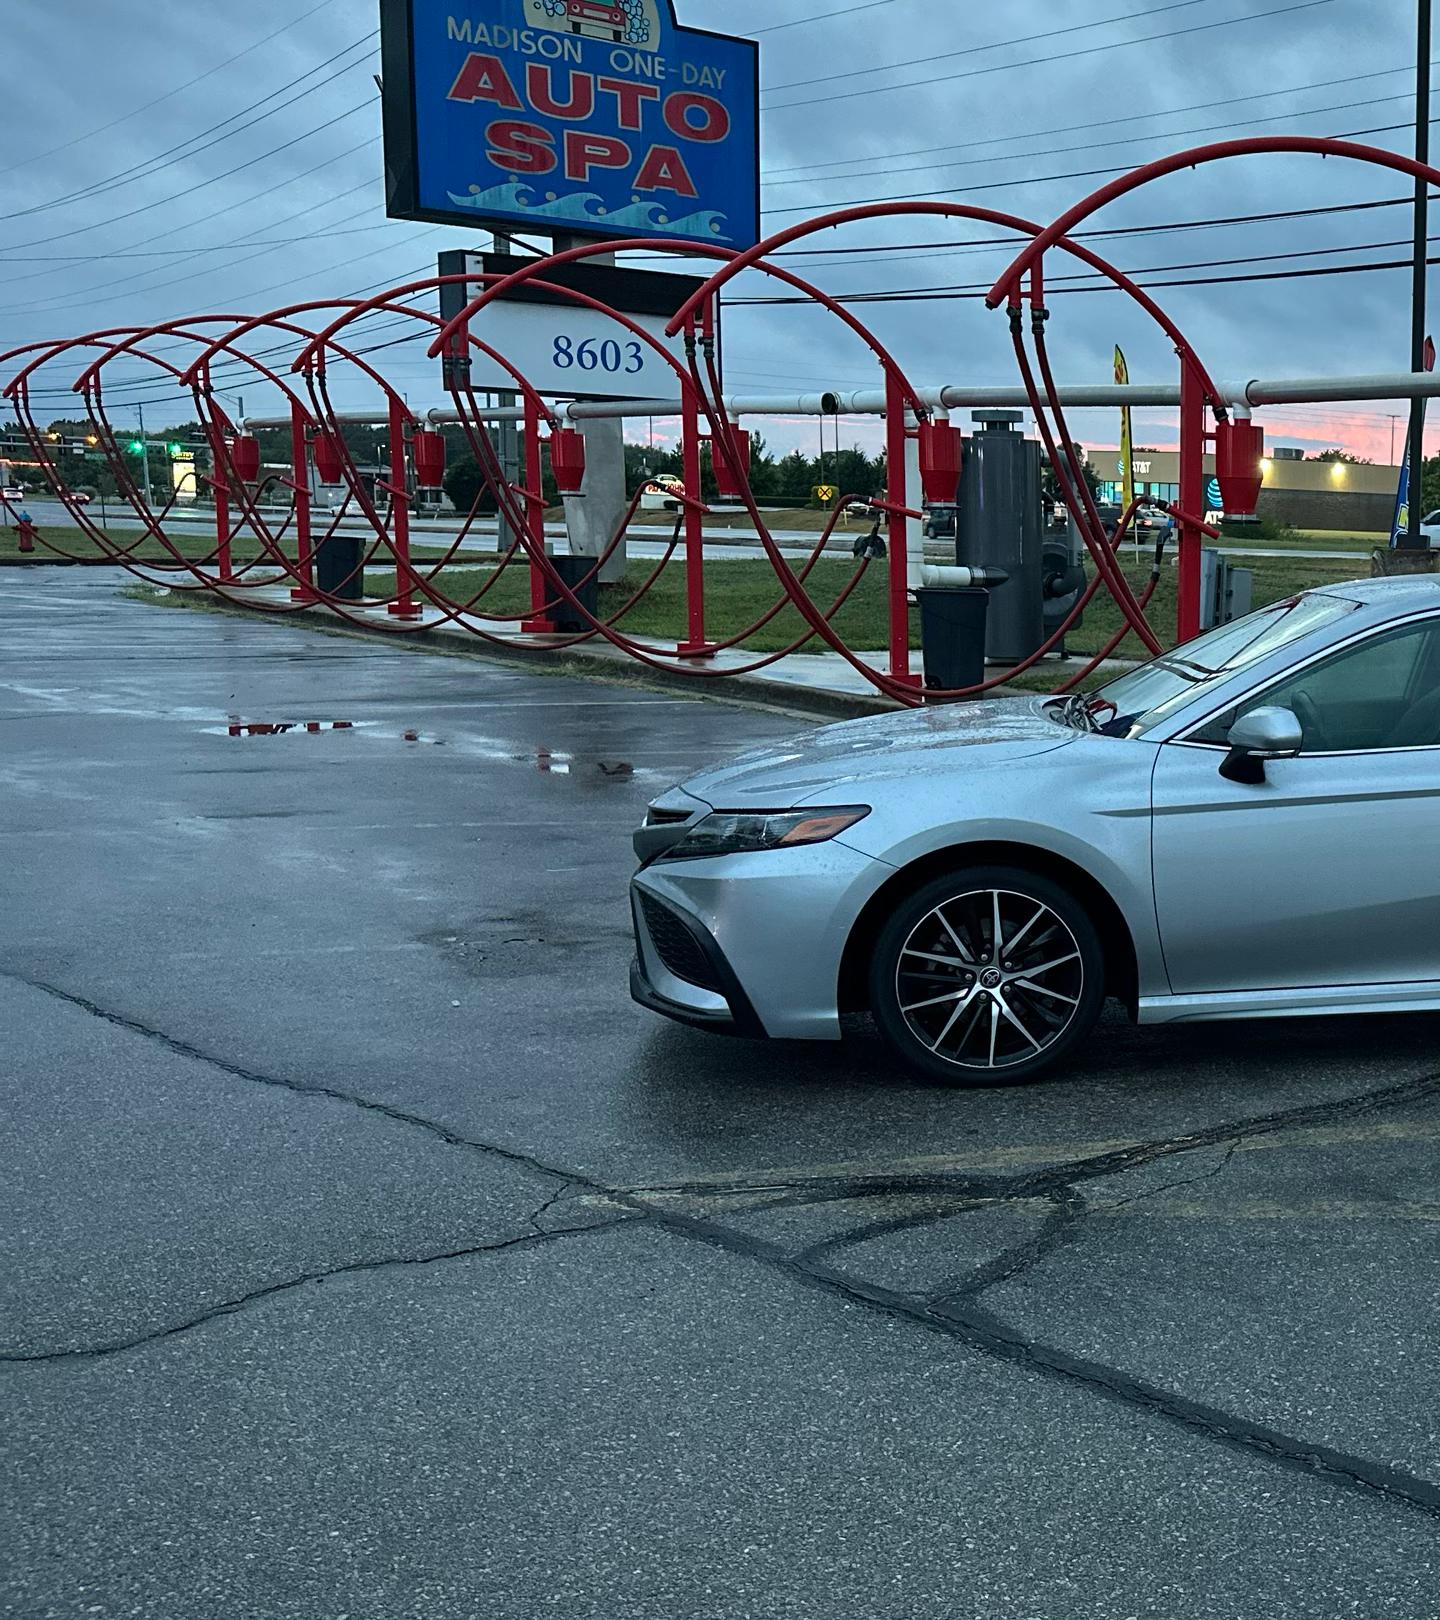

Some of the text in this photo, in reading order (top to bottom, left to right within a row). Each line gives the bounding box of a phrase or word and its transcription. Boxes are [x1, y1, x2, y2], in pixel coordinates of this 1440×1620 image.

[447, 16, 727, 90] MADISON ONE-DAY
[446, 51, 731, 144] AUTO
[485, 120, 699, 198] SPA
[552, 335, 644, 374] 8603
